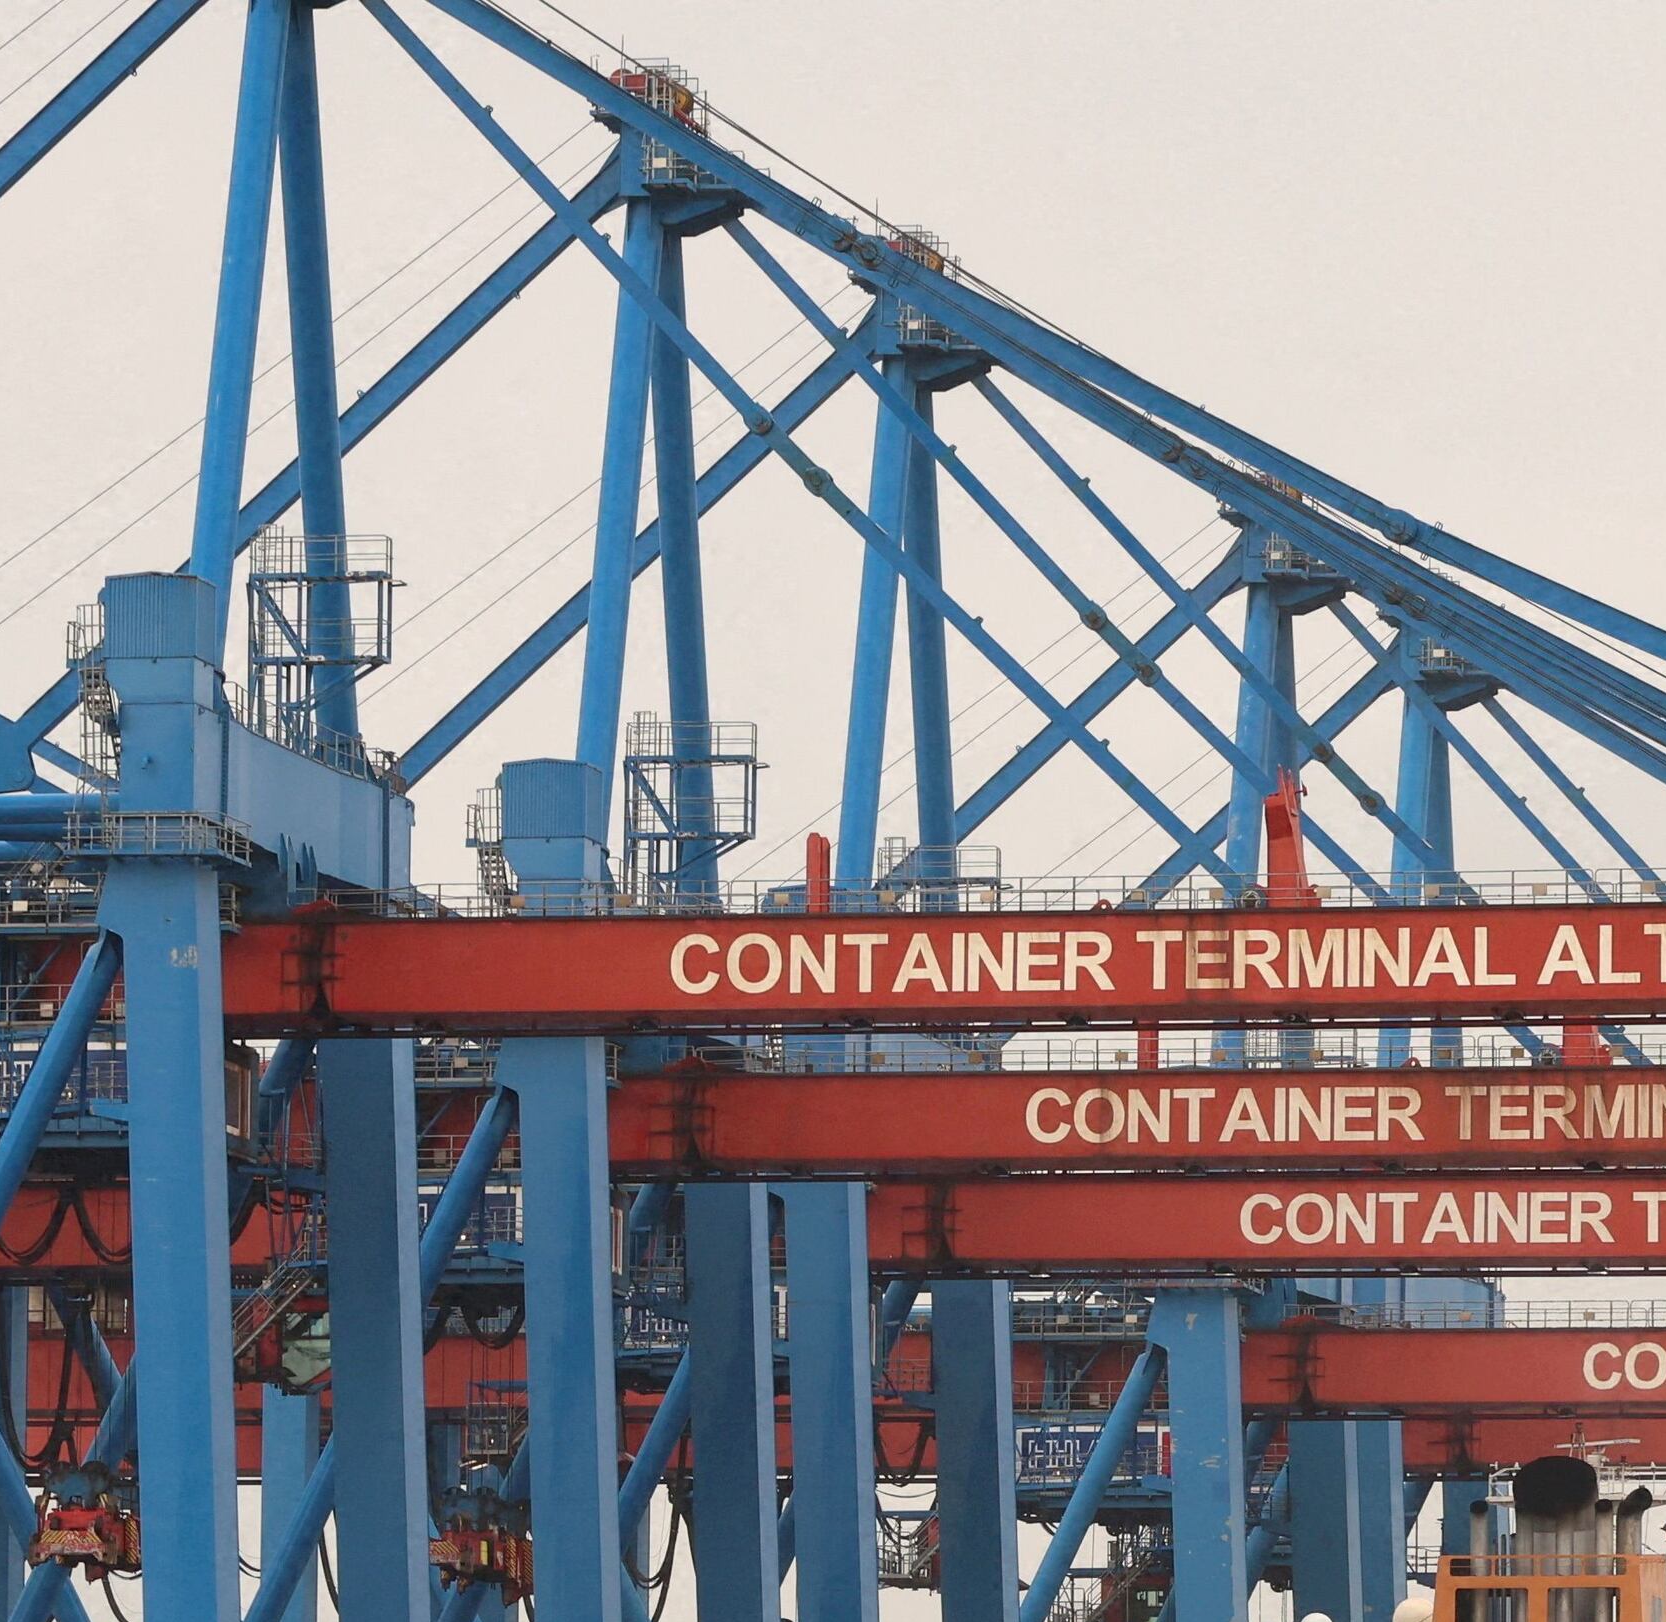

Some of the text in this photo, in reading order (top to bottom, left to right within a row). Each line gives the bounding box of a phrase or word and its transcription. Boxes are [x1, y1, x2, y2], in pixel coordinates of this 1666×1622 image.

[670, 931, 1116, 995] CONTAINER
[1136, 927, 1517, 990] TERMINAL
[1025, 1087, 1424, 1144] CONTAINER
[1239, 1191, 1615, 1246] CONTAINER
